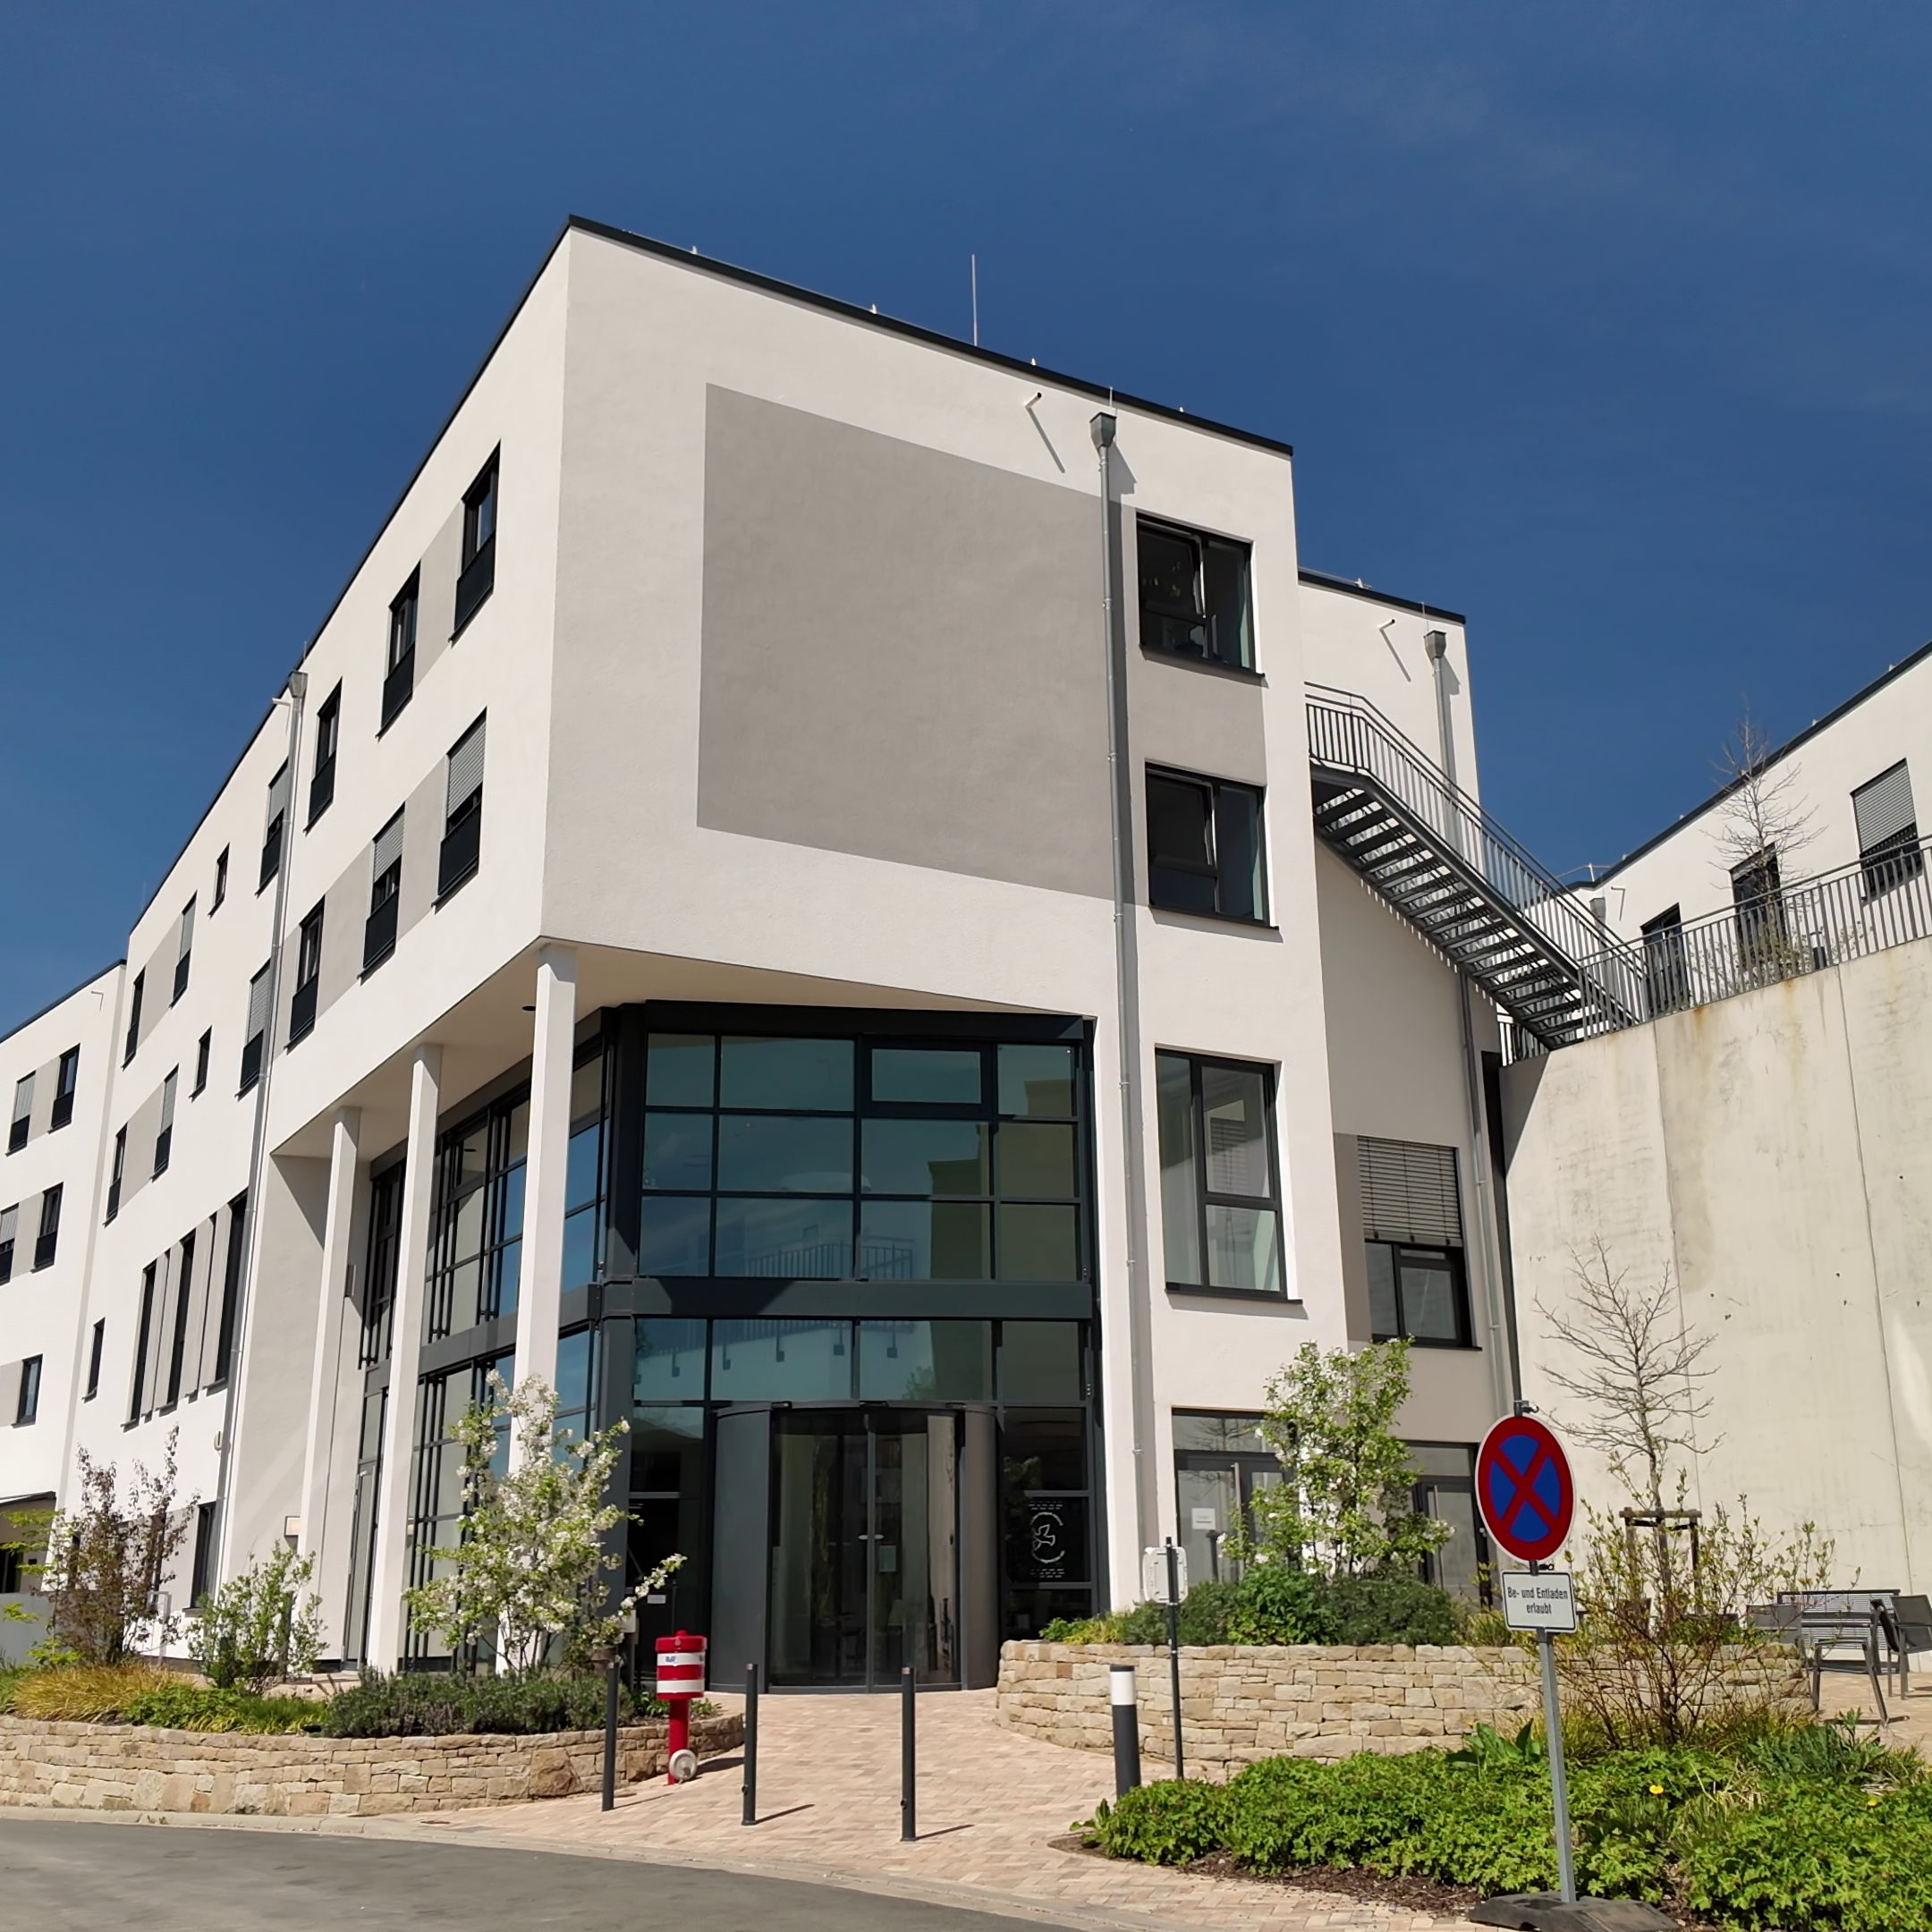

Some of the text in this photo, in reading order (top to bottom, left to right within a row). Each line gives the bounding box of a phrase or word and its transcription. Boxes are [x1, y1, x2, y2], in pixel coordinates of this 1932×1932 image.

[1521, 1587, 1535, 1598] und
[1536, 1587, 1569, 1599] Entladen
[1526, 1602, 1552, 1614] erlaubt
